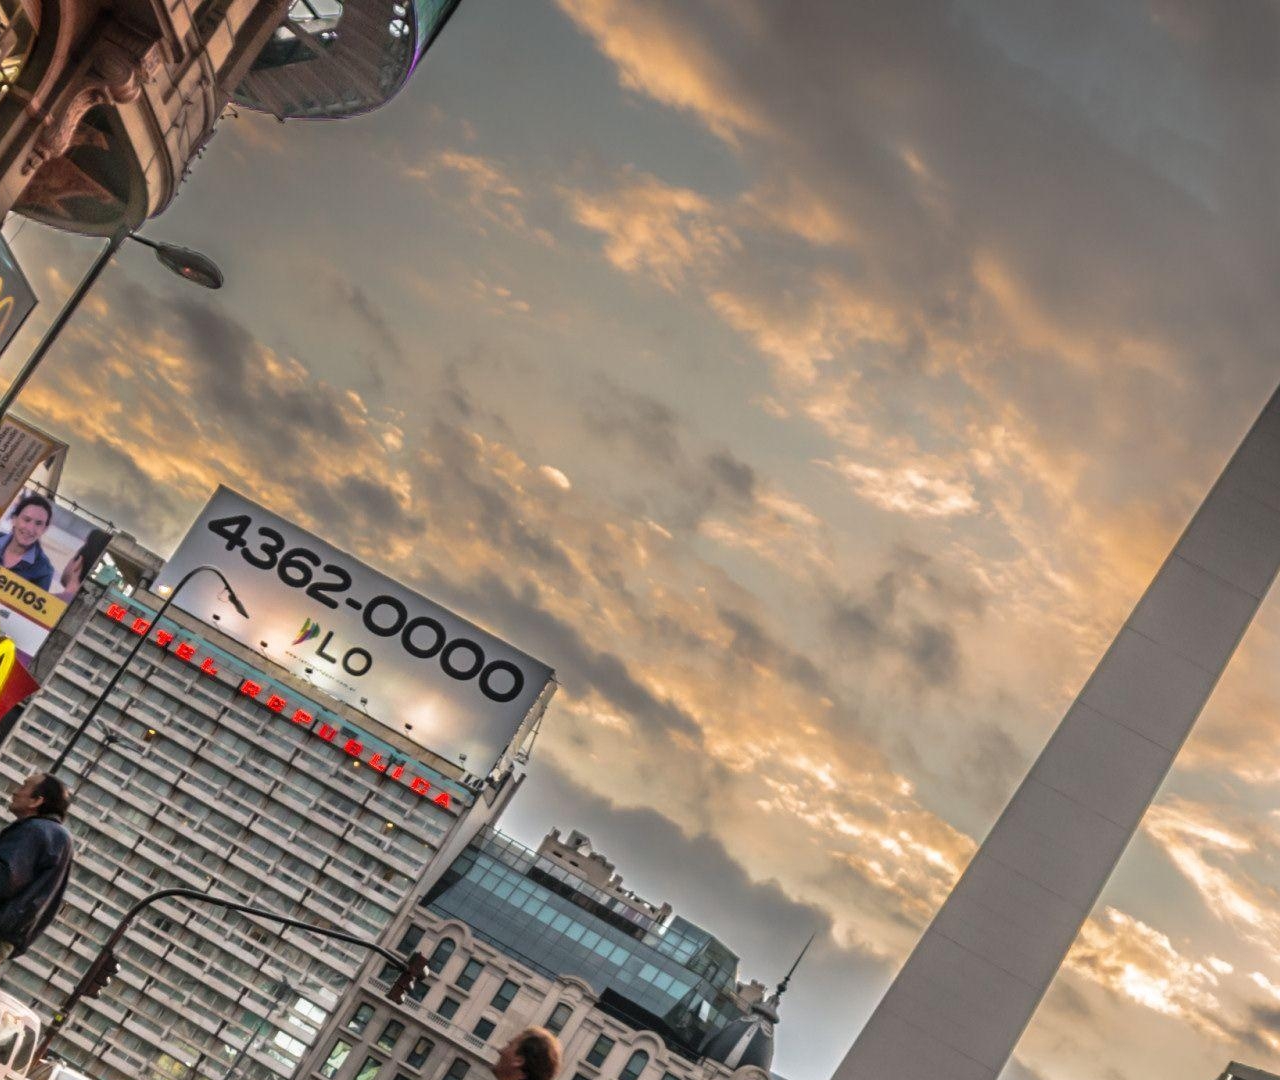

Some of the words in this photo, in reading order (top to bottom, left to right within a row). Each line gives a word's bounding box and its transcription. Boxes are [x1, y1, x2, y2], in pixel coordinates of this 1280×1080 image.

[106, 602, 217, 677] HOTEL
[241, 679, 451, 808] REPUBLICA
[208, 514, 524, 702] 4362-0000
